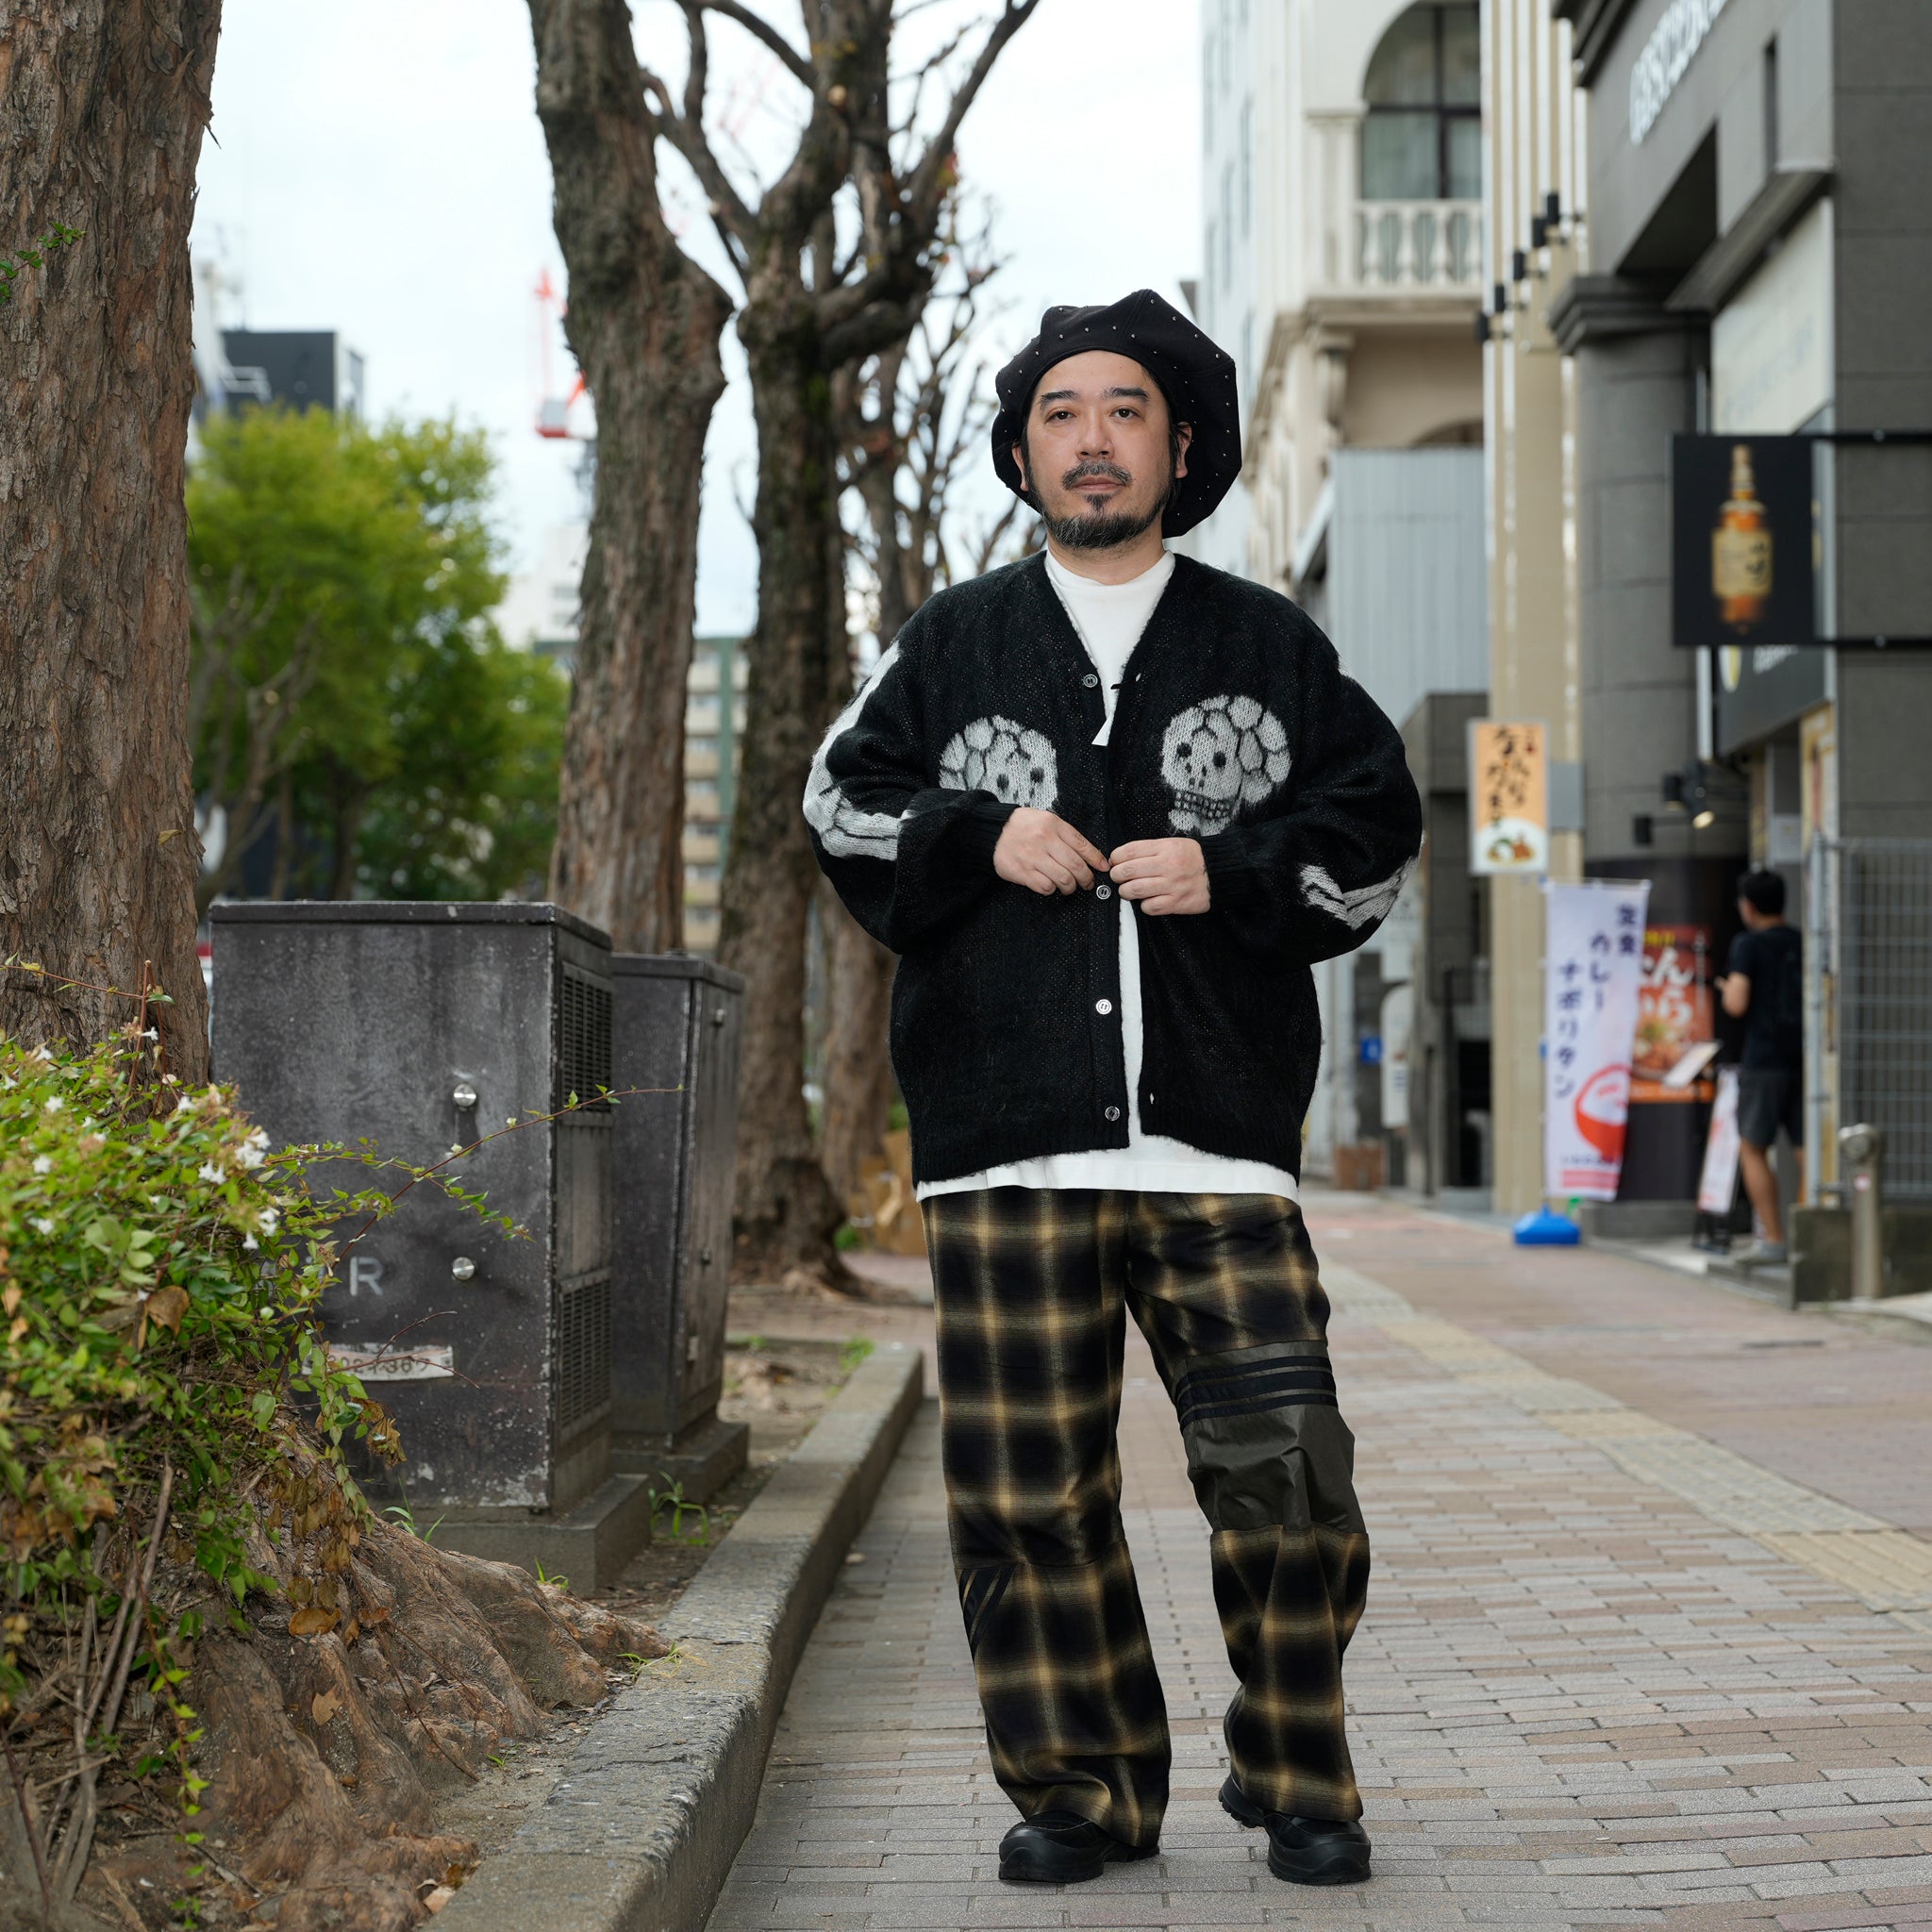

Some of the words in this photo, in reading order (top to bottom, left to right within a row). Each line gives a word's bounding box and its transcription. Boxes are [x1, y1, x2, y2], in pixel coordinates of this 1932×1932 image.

[1555, 958, 1582, 1099] ナポリタン
